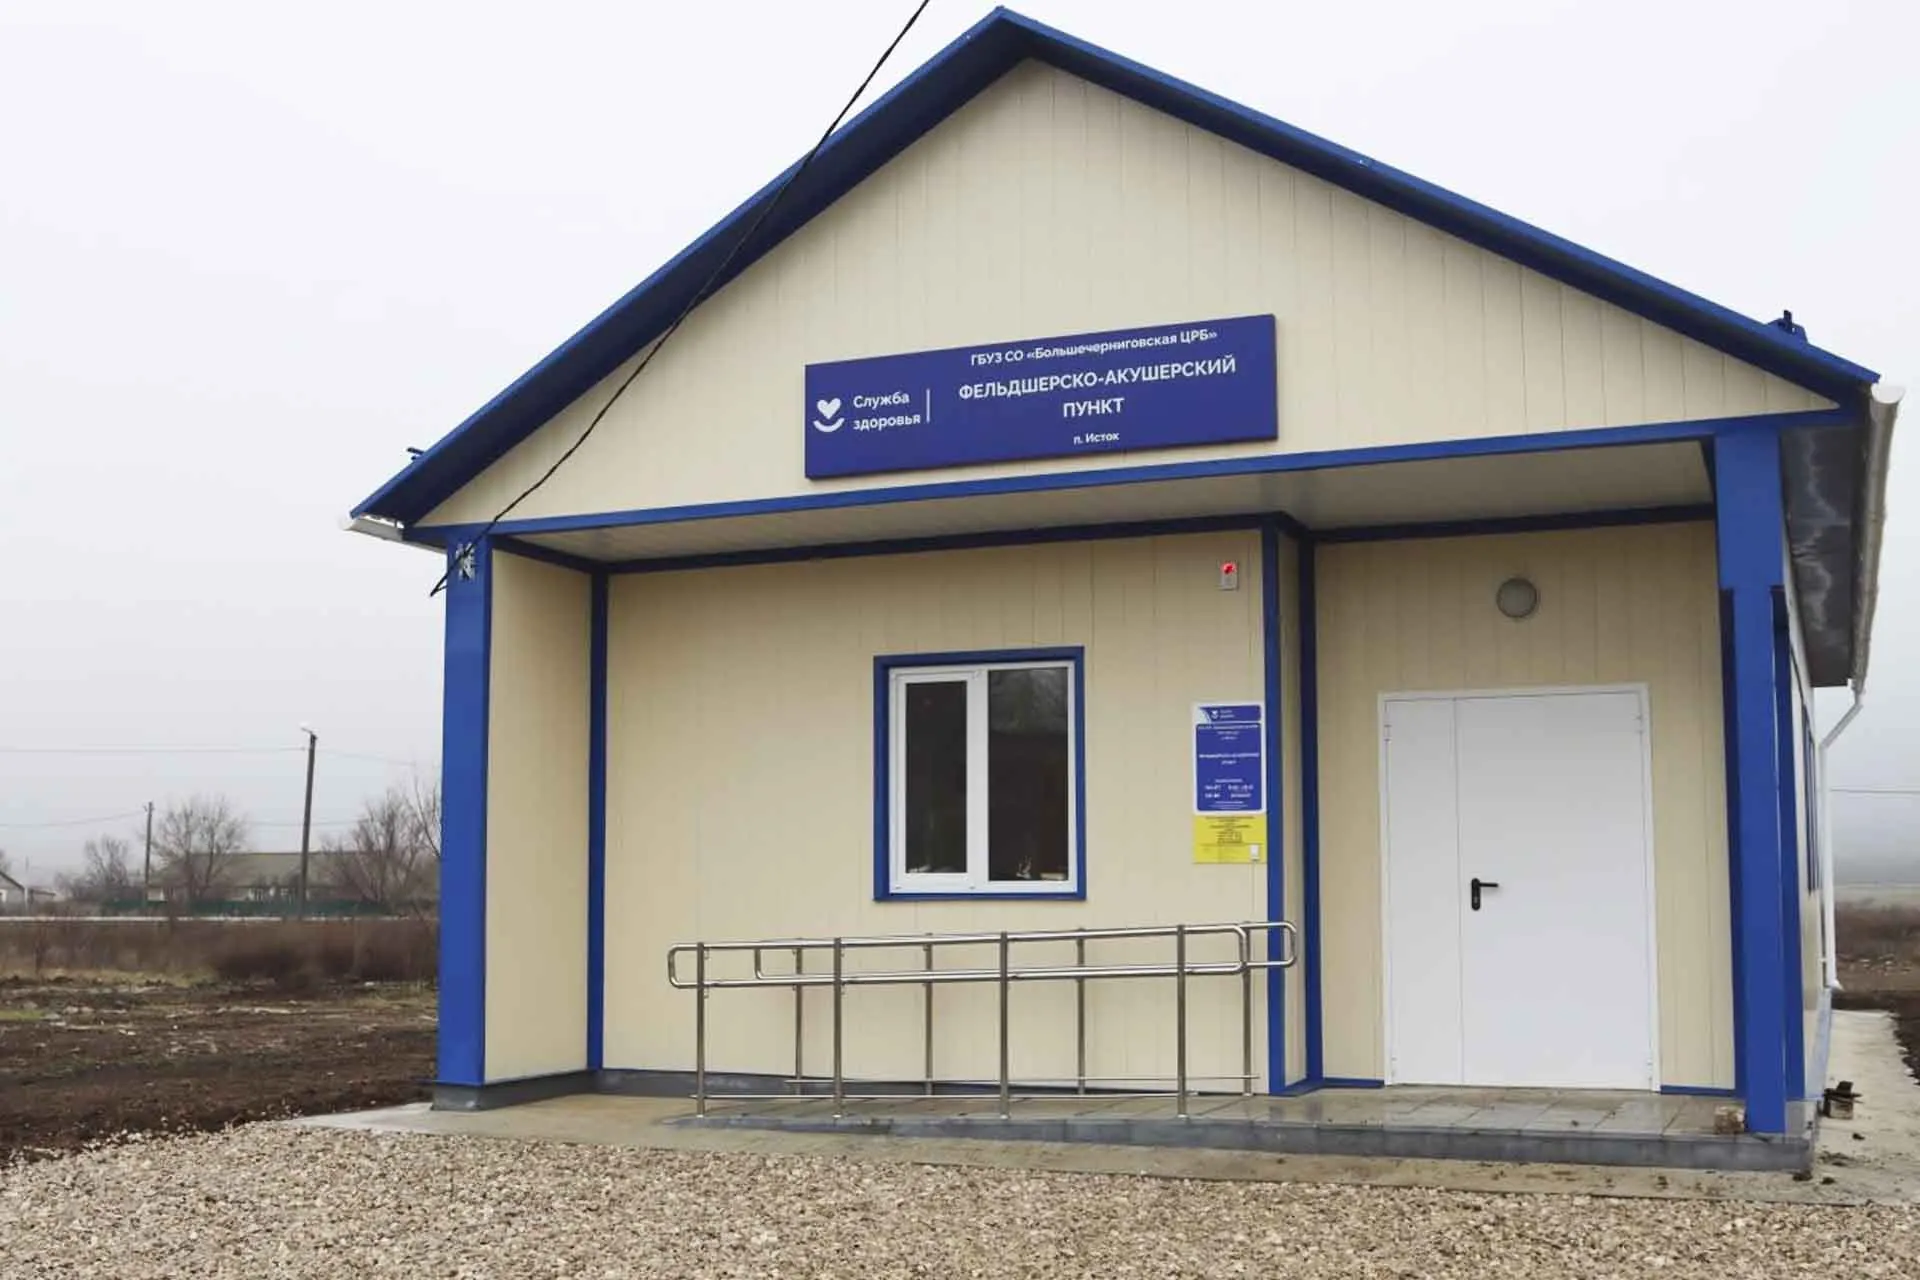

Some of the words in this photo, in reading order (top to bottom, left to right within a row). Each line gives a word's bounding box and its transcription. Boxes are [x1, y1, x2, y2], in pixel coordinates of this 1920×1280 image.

[970, 351, 1003, 366] ГБУЗ
[1004, 349, 1024, 363] СО
[1026, 334, 1178, 360] «Большечерниговская
[1179, 328, 1218, 345] ЦРБ»
[958, 354, 1236, 400] ФЕЛЬДШЕРСКО-АКУШЕРСКИЙ
[853, 390, 910, 410] Служба
[1062, 396, 1125, 418] ПУНКТ
[853, 414, 921, 432] здоровья
[1073, 434, 1083, 445] п.
[1085, 431, 1120, 444] Исток
